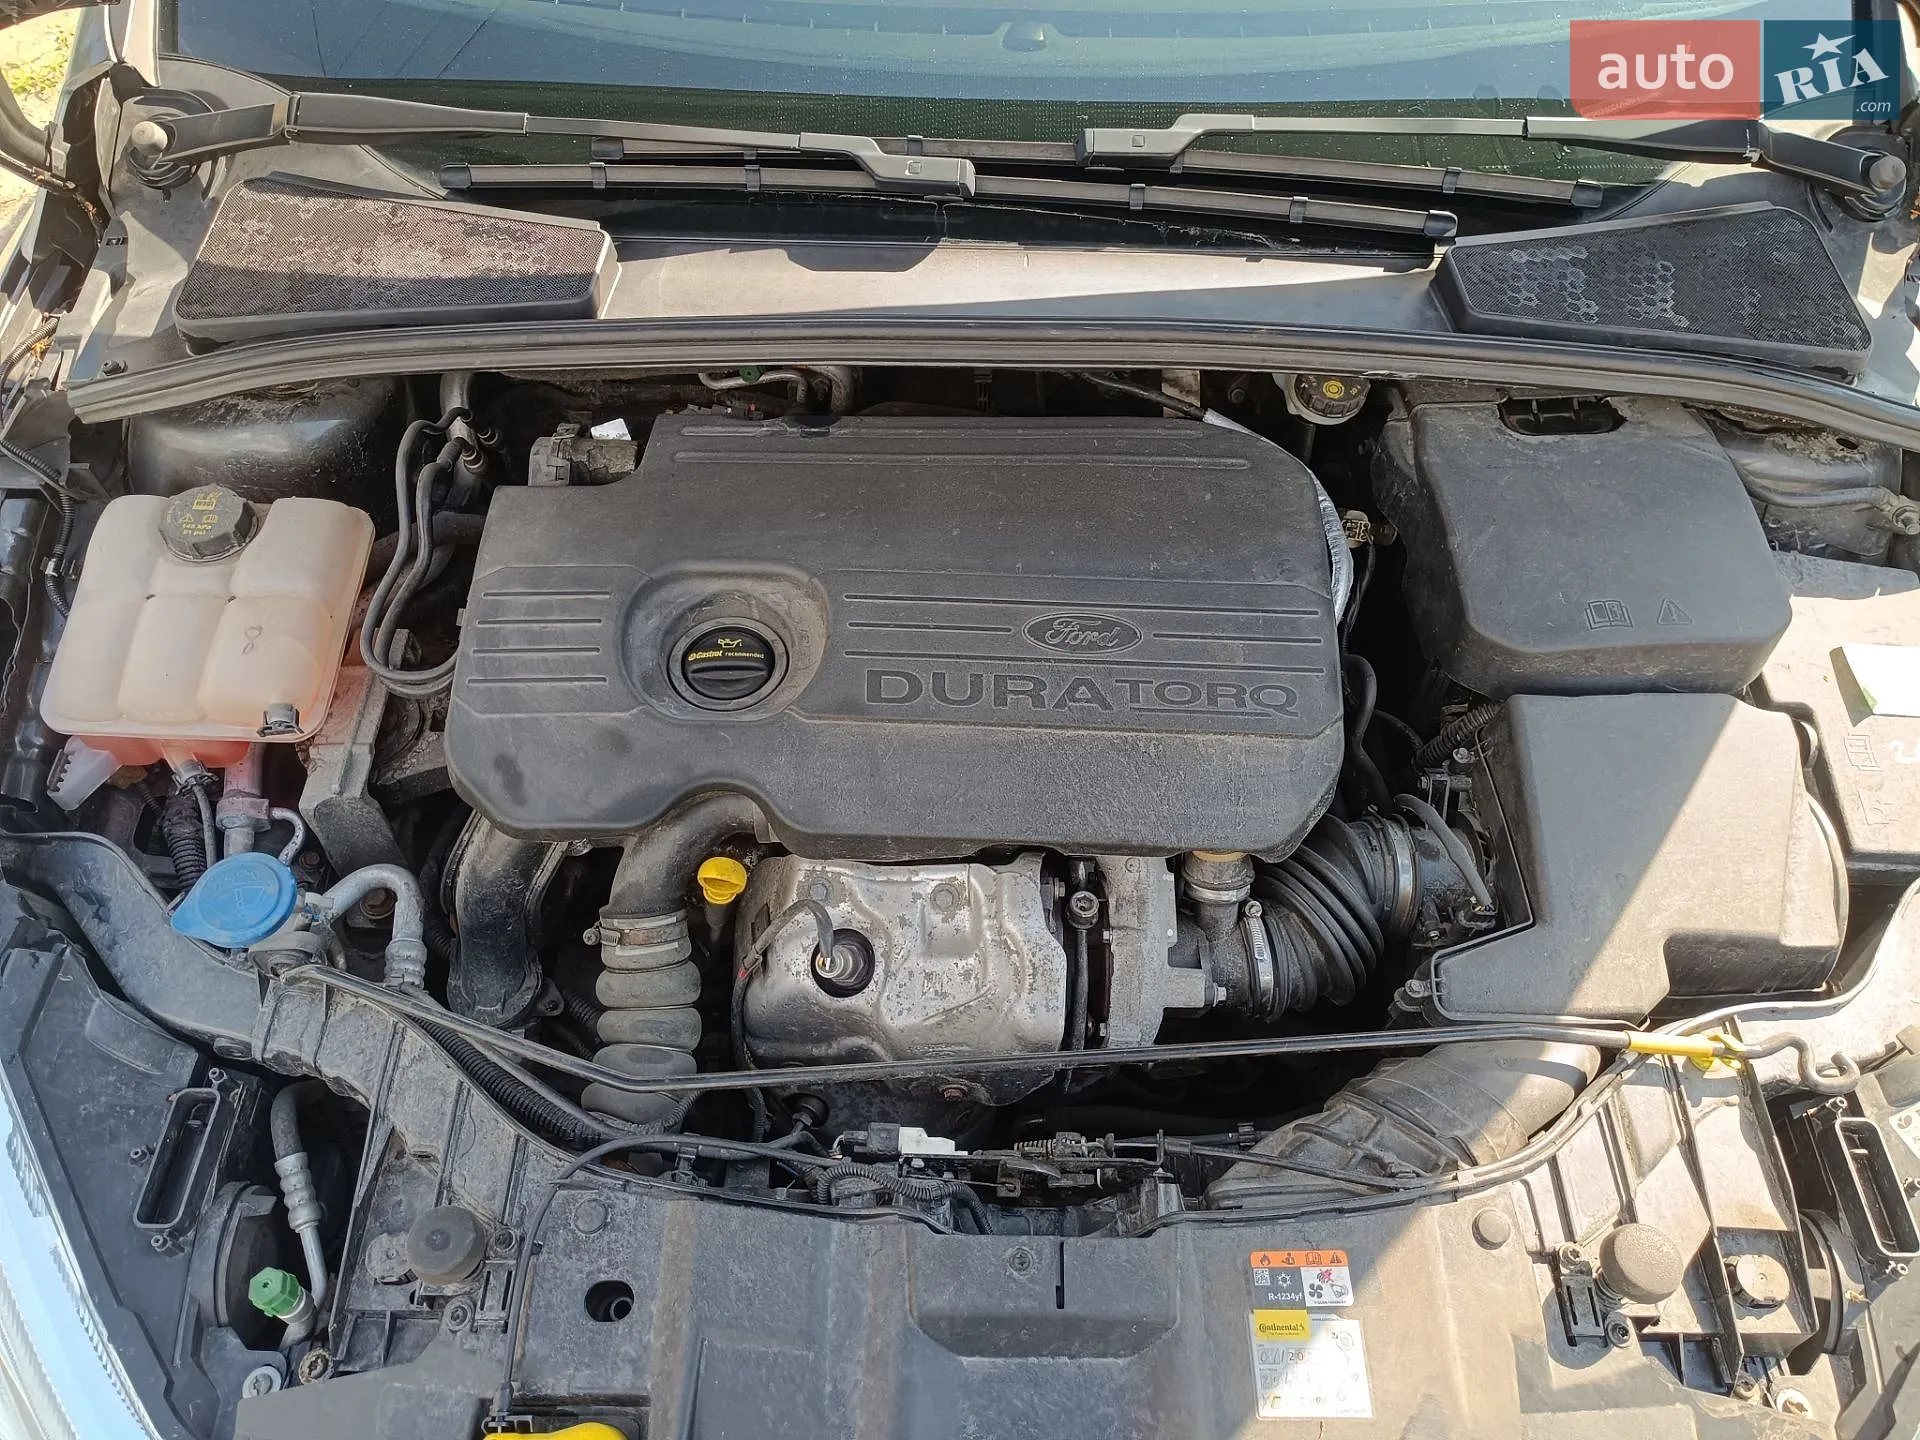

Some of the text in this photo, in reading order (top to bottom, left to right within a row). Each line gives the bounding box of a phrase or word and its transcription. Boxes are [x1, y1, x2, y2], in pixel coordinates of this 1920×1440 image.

[1045, 618, 1121, 648] Ford
[695, 650, 765, 659] Castrol recommended
[864, 668, 1300, 718] DURATORQ
[1268, 1291, 1304, 1302] R-1234yf
[1258, 1322, 1299, 1334] Continental
